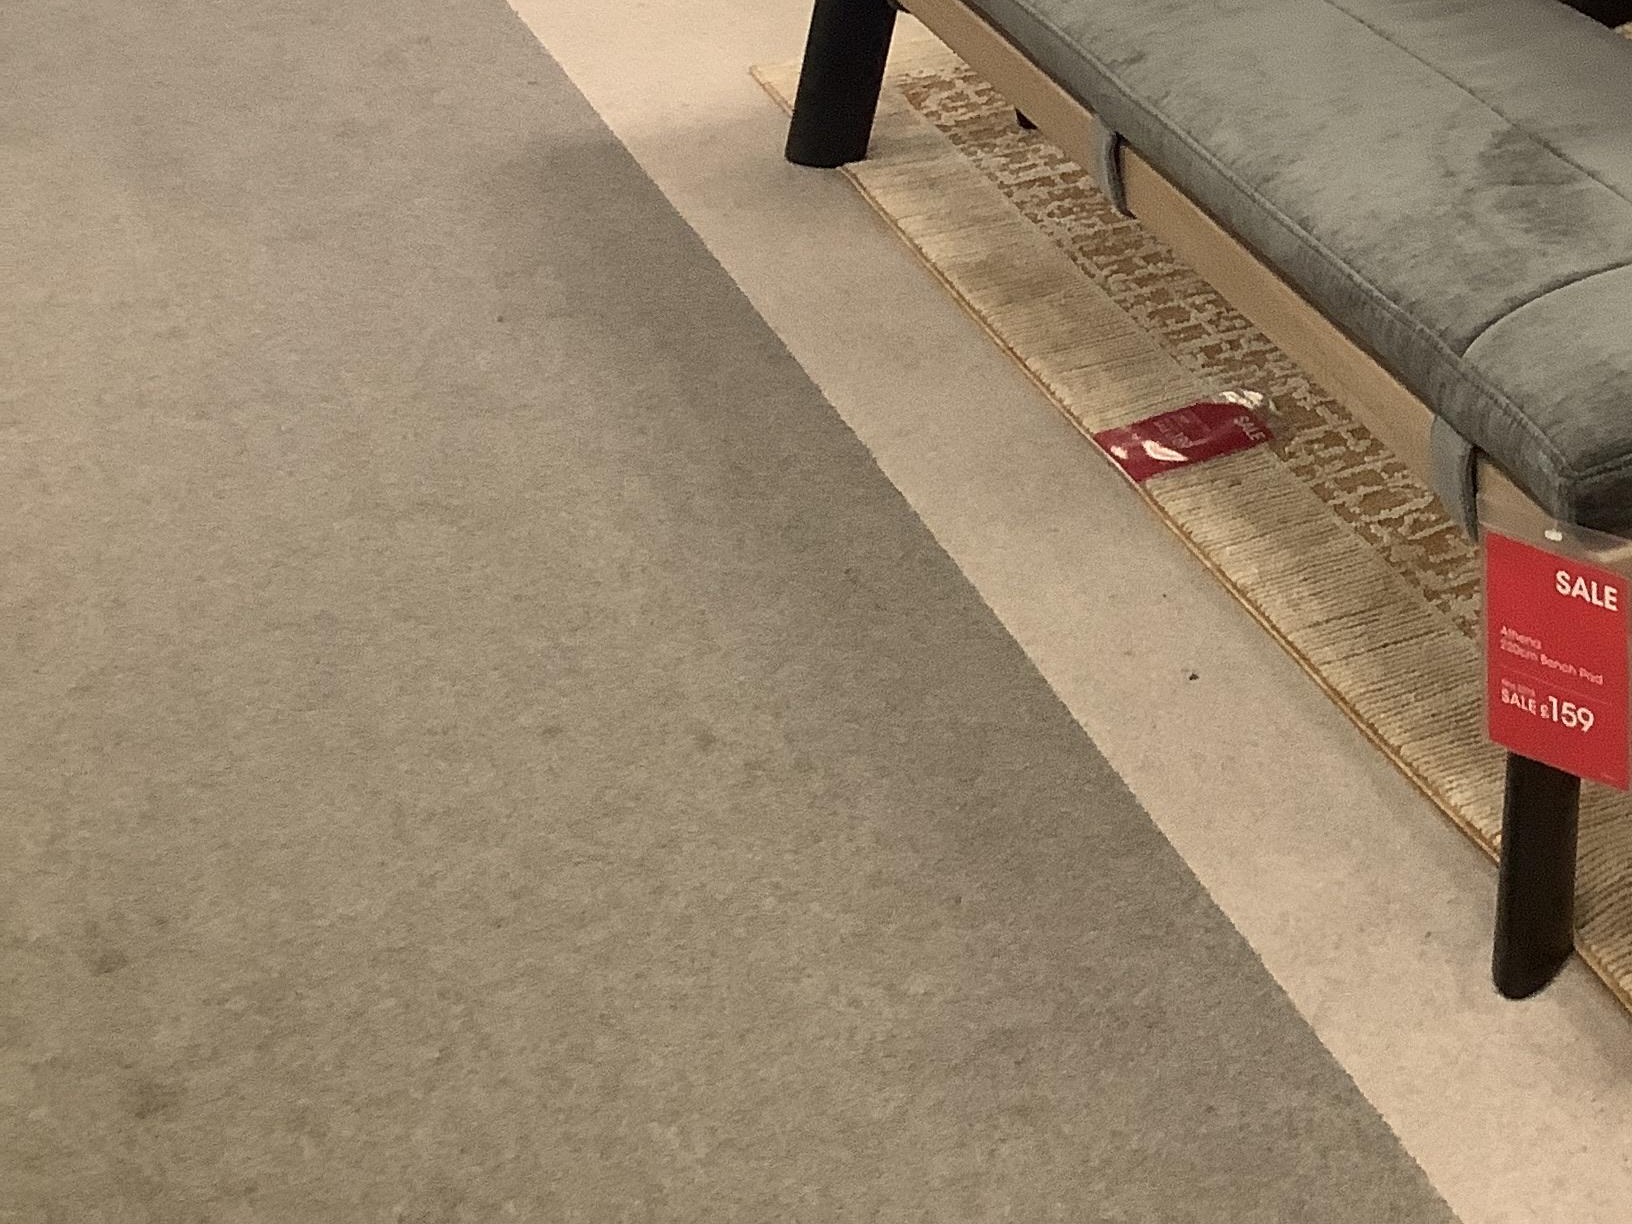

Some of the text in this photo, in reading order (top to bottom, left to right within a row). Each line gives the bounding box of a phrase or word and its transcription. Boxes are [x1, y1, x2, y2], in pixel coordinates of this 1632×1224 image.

[1555, 569, 1619, 612] SALE
[1540, 653, 1578, 676] Bench
[1579, 667, 1604, 686] Pad
[1501, 688, 1537, 716] SALE
[1540, 695, 1595, 733] £159
